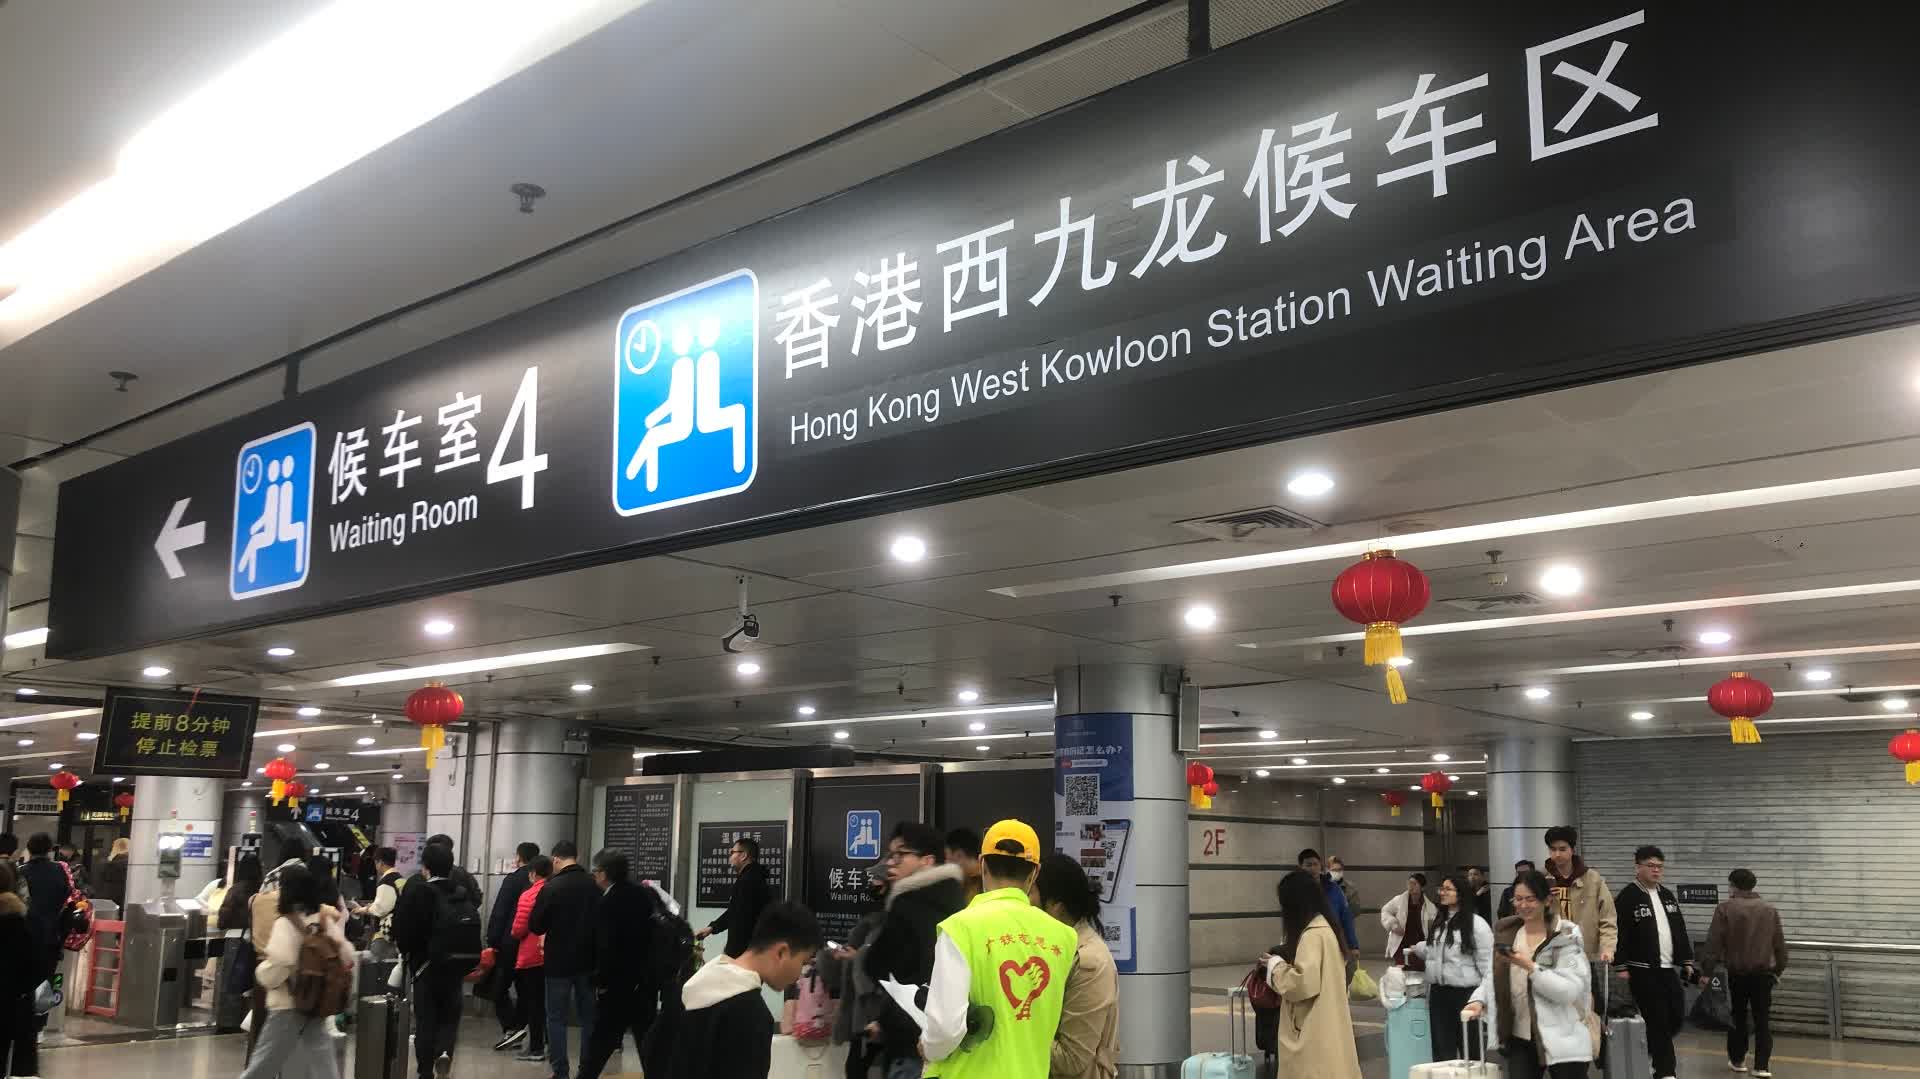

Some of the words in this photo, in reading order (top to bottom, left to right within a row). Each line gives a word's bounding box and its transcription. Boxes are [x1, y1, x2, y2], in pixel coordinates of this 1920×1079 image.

[774, 9, 1658, 380] 香港西九龙候车区
[790, 408, 858, 445] Hong
[868, 386, 940, 428] Kong
[951, 360, 1030, 407] West
[1041, 324, 1191, 388] Kowloon
[1207, 286, 1351, 348] Station
[1367, 234, 1547, 307] Waiting
[1564, 197, 1697, 260] Area
[328, 391, 482, 505] 候车室
[486, 365, 549, 510] 4
[329, 512, 406, 553] Waiting
[411, 495, 478, 534] Room
[130, 711, 231, 735] 提前8分钟
[136, 736, 220, 758] 停止检票
[1203, 829, 1226, 856] 2F
[831, 891, 858, 904] Waiting
